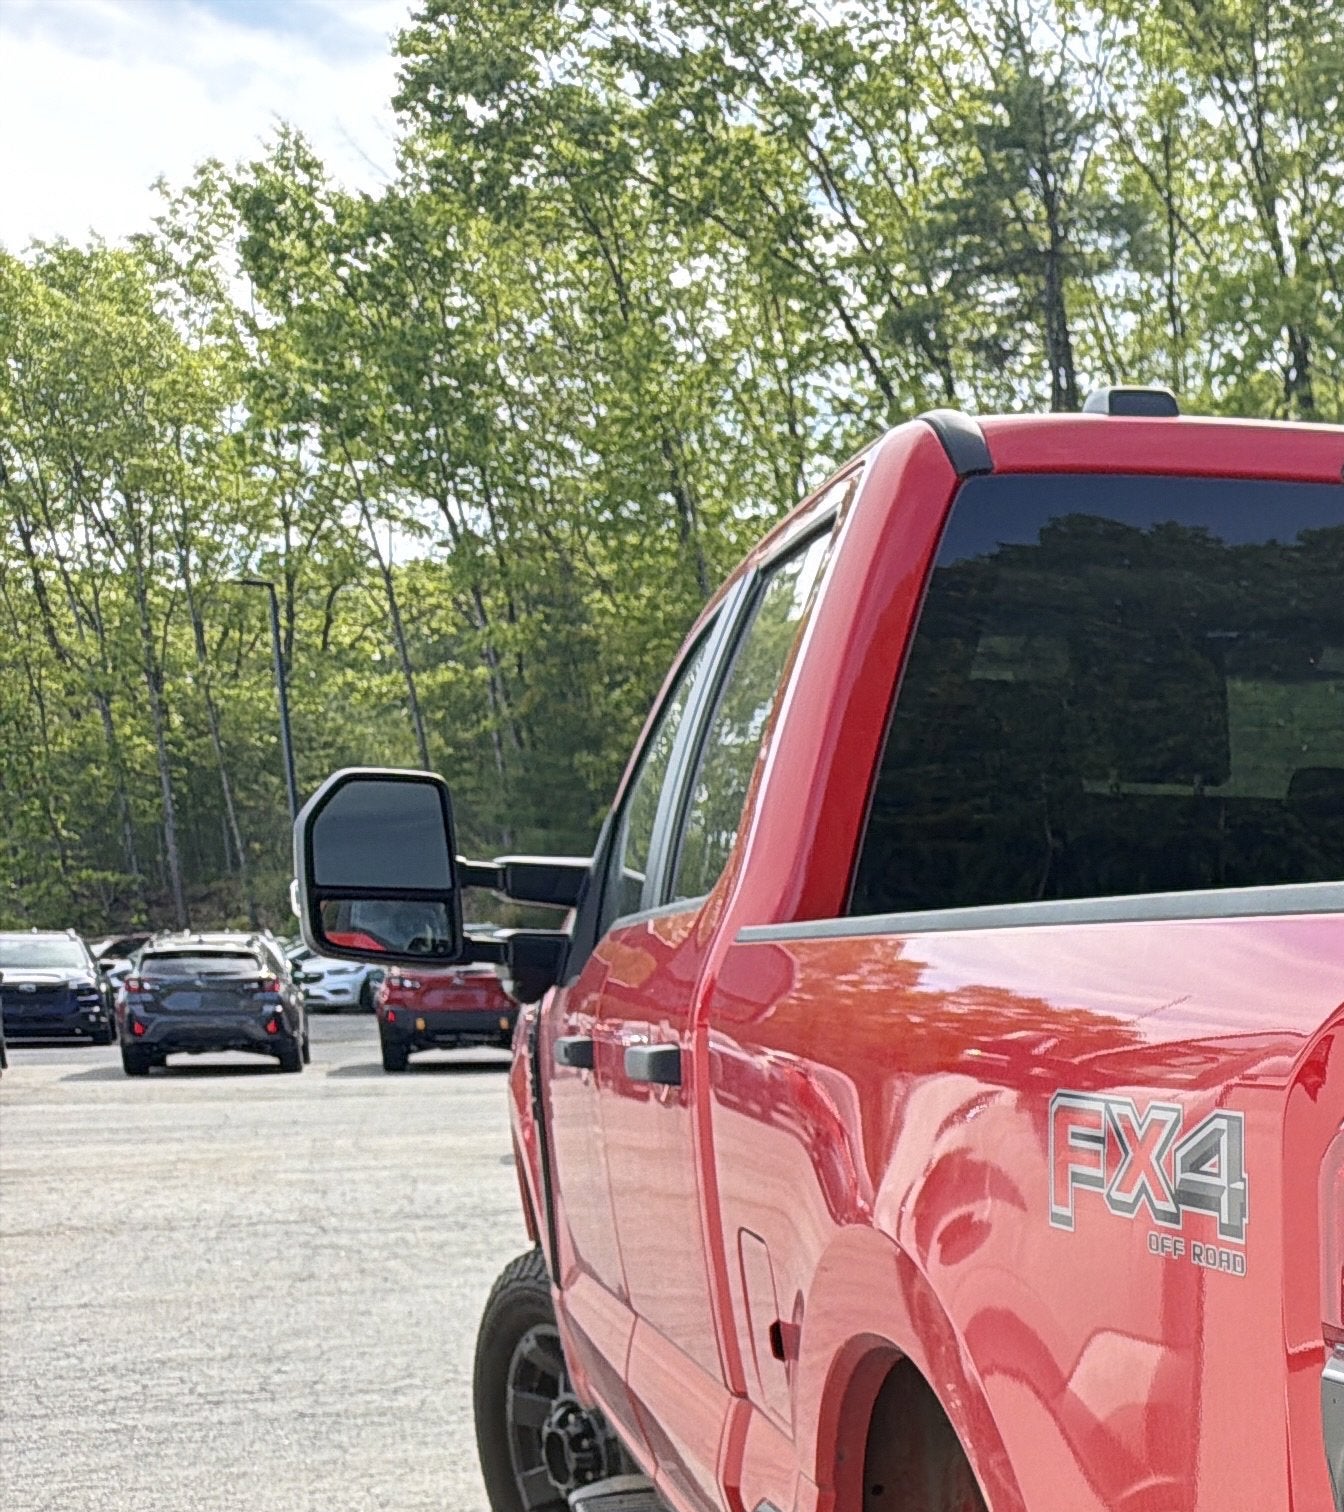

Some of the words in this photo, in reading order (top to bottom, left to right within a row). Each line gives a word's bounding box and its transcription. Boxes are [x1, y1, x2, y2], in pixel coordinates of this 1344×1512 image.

[1049, 1088, 1249, 1244] FX4
[1148, 1231, 1185, 1259] OFF
[1191, 1241, 1247, 1277] ROAD
